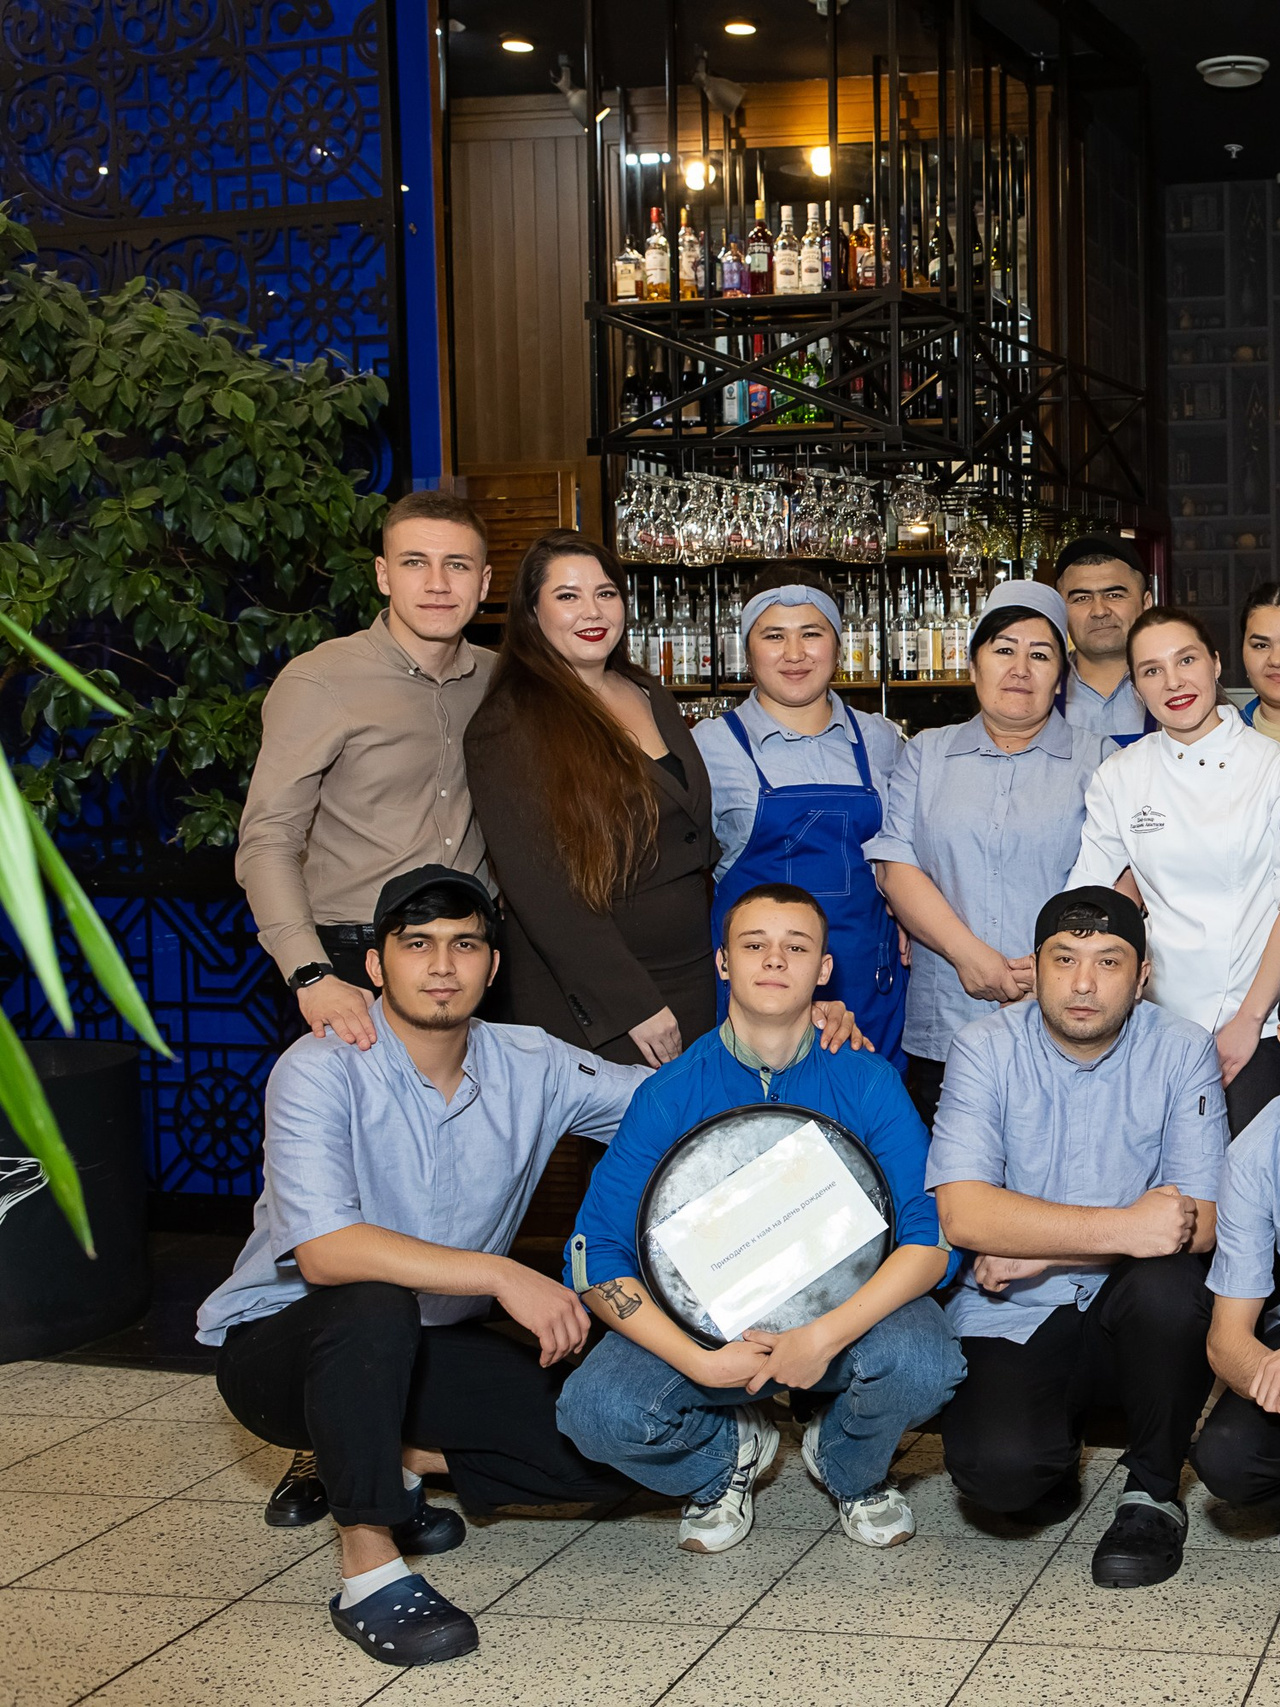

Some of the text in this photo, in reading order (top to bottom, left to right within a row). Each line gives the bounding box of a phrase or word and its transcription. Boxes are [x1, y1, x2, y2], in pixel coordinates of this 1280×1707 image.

[710, 1240, 751, 1272] Приходите
[756, 1226, 773, 1240] нам
[772, 1219, 783, 1229] на
[782, 1207, 801, 1223] день
